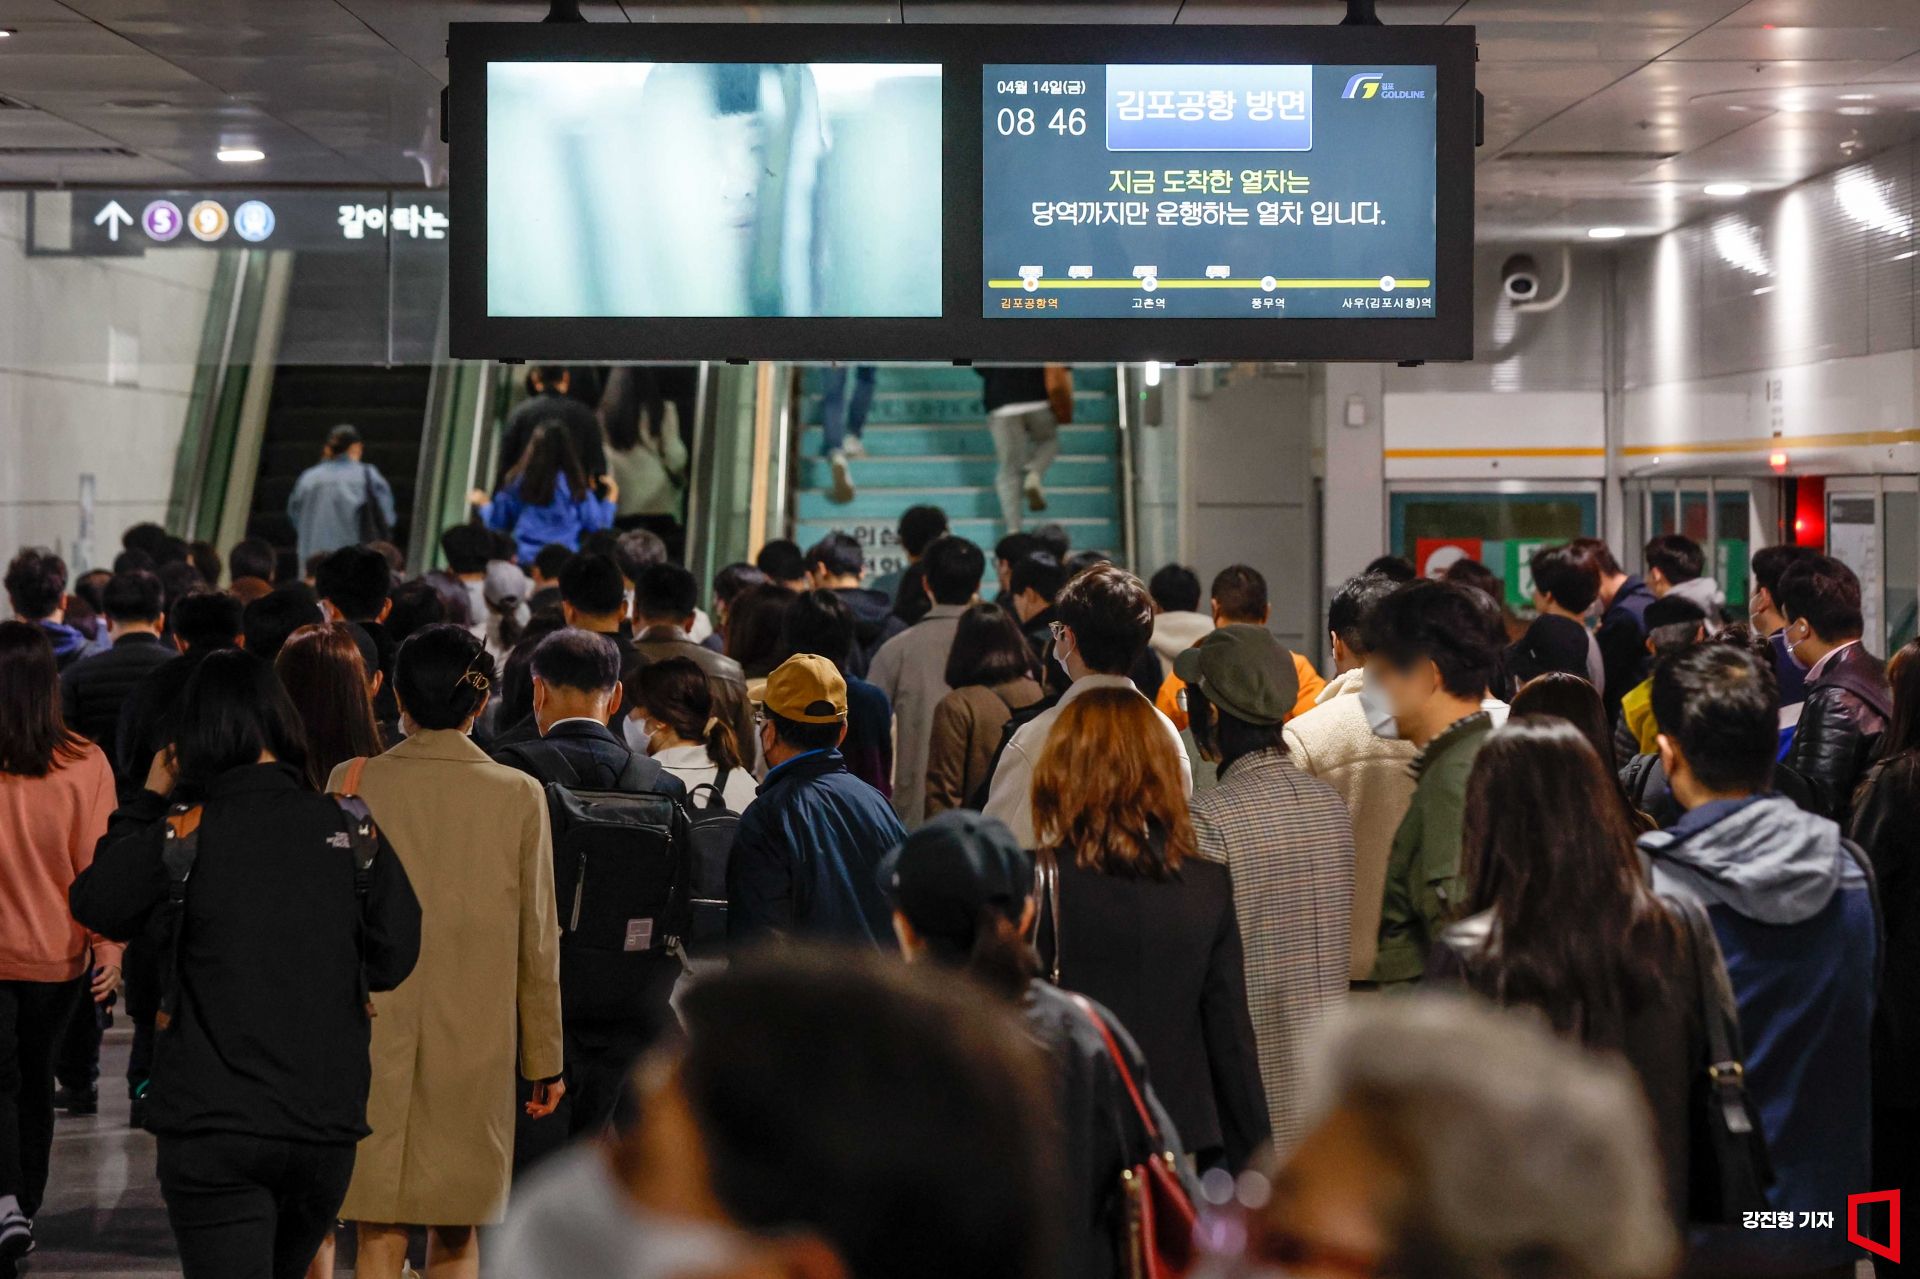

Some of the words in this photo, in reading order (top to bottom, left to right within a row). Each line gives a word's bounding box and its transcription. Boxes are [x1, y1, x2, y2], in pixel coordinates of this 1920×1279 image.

[997, 80, 1028, 95] 04월
[1032, 80, 1087, 95] 14일(금)
[1380, 90, 1426, 99] GOLDLINE
[1115, 89, 1237, 122] 김포공항
[1245, 89, 1306, 122] 방면
[997, 107, 1036, 136] 08
[1048, 107, 1087, 136] 46
[1108, 169, 1156, 195] 지금
[1162, 169, 1233, 195] 도착한
[1239, 169, 1311, 195] 열차는
[198, 207, 218, 232] 9
[1031, 201, 1150, 227] 당역까지만
[1155, 201, 1250, 227] 운행하는
[1256, 201, 1304, 227] 열차
[1310, 201, 1386, 227] 입니다.
[1001, 298, 1058, 309] 김포공항역
[1131, 298, 1166, 309] 고촌역
[1251, 298, 1285, 309] 풍무역
[1342, 298, 1432, 310] 사우(김포시청)역
